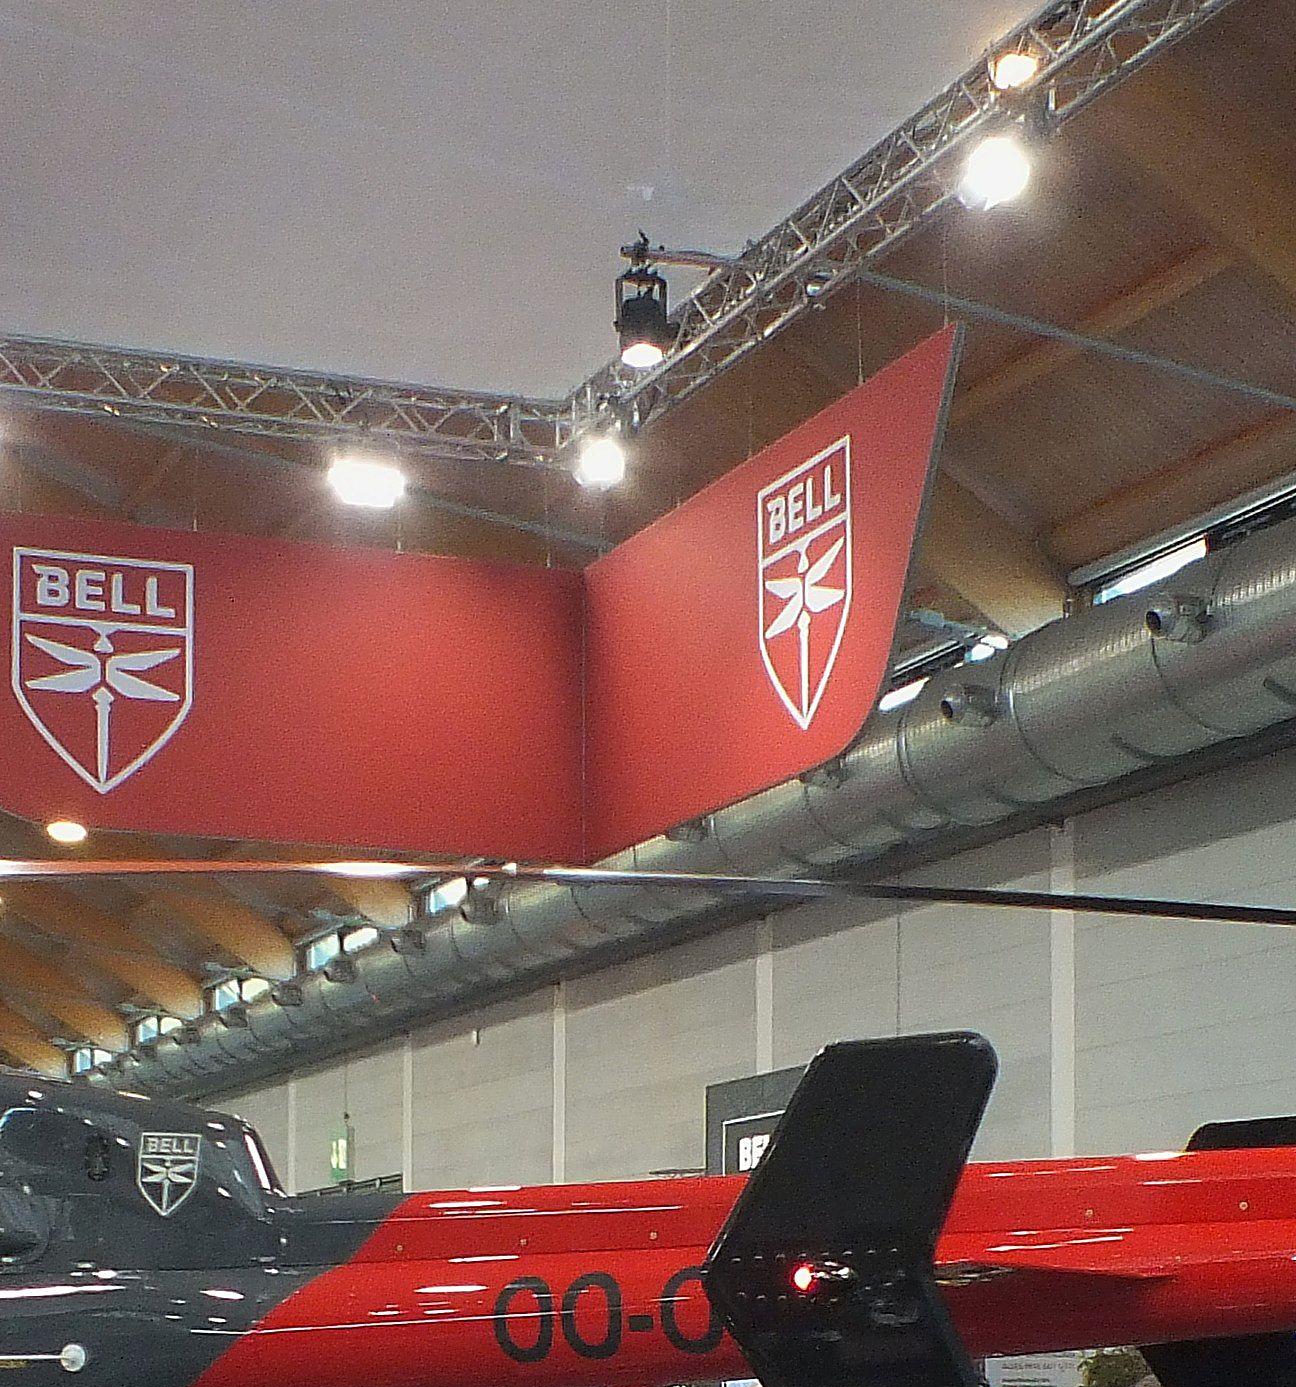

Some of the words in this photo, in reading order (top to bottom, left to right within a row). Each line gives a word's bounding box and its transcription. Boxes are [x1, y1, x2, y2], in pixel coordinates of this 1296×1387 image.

[767, 464, 840, 544] BELL
[31, 563, 176, 618] BELL
[146, 1137, 194, 1153] BELL
